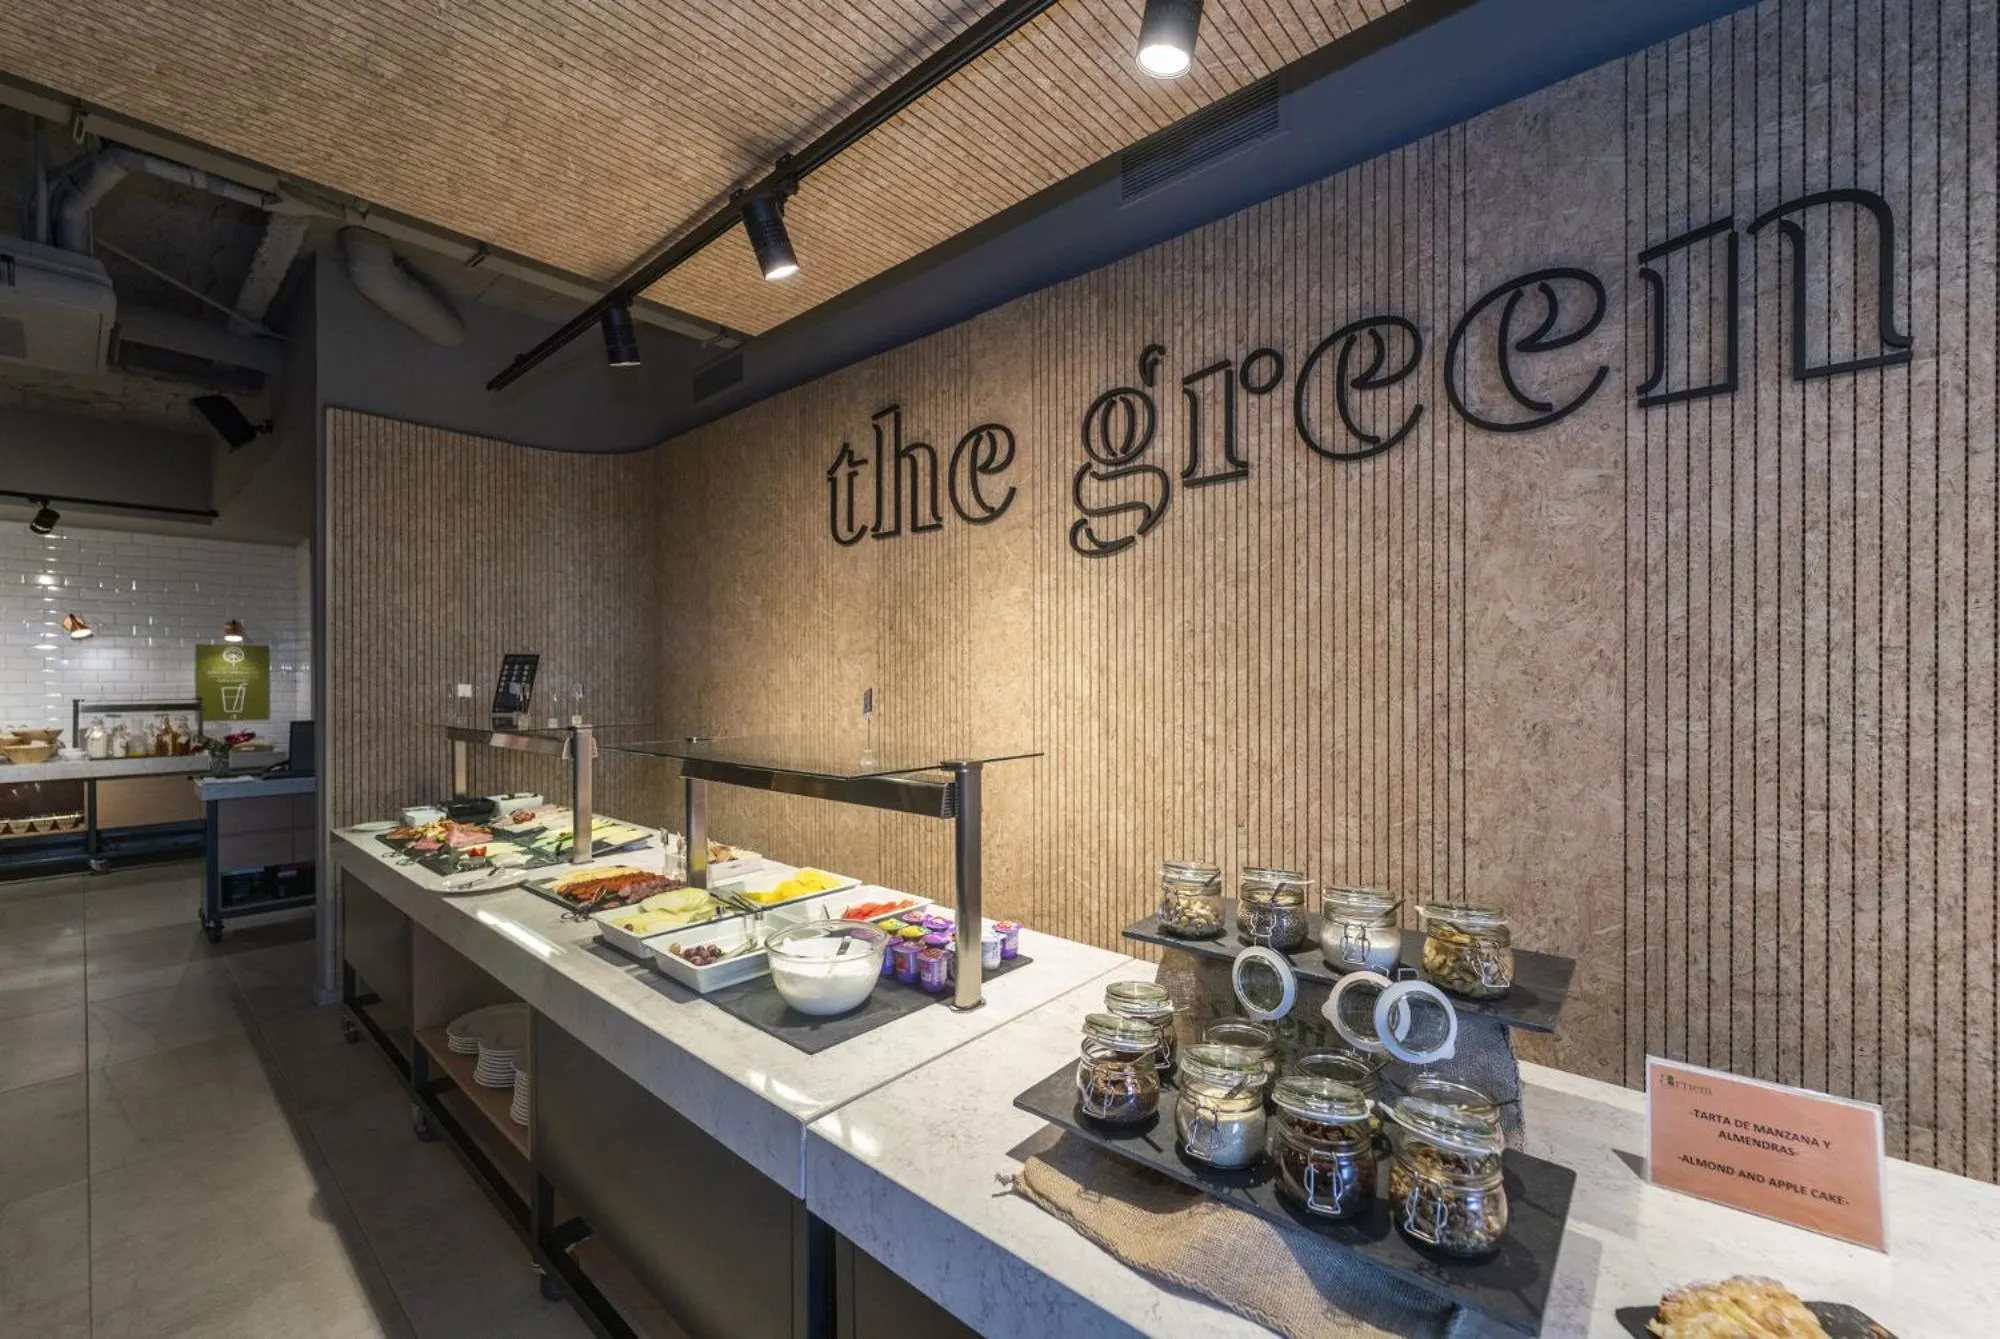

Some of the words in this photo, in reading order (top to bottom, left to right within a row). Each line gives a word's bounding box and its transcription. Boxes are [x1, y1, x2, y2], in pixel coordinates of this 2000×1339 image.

[827, 404, 1017, 547] the
[1069, 188, 1914, 558] green
[1734, 1119, 1752, 1130] DE
[1753, 1122, 1820, 1148] MANZANA
[1821, 1138, 1831, 1150] Y
[1677, 1153, 1735, 1176] -ALMOND
[1738, 1168, 1766, 1184] AND
[1768, 1177, 1808, 1196] APPLE
[1810, 1187, 1851, 1206] CAKE-
